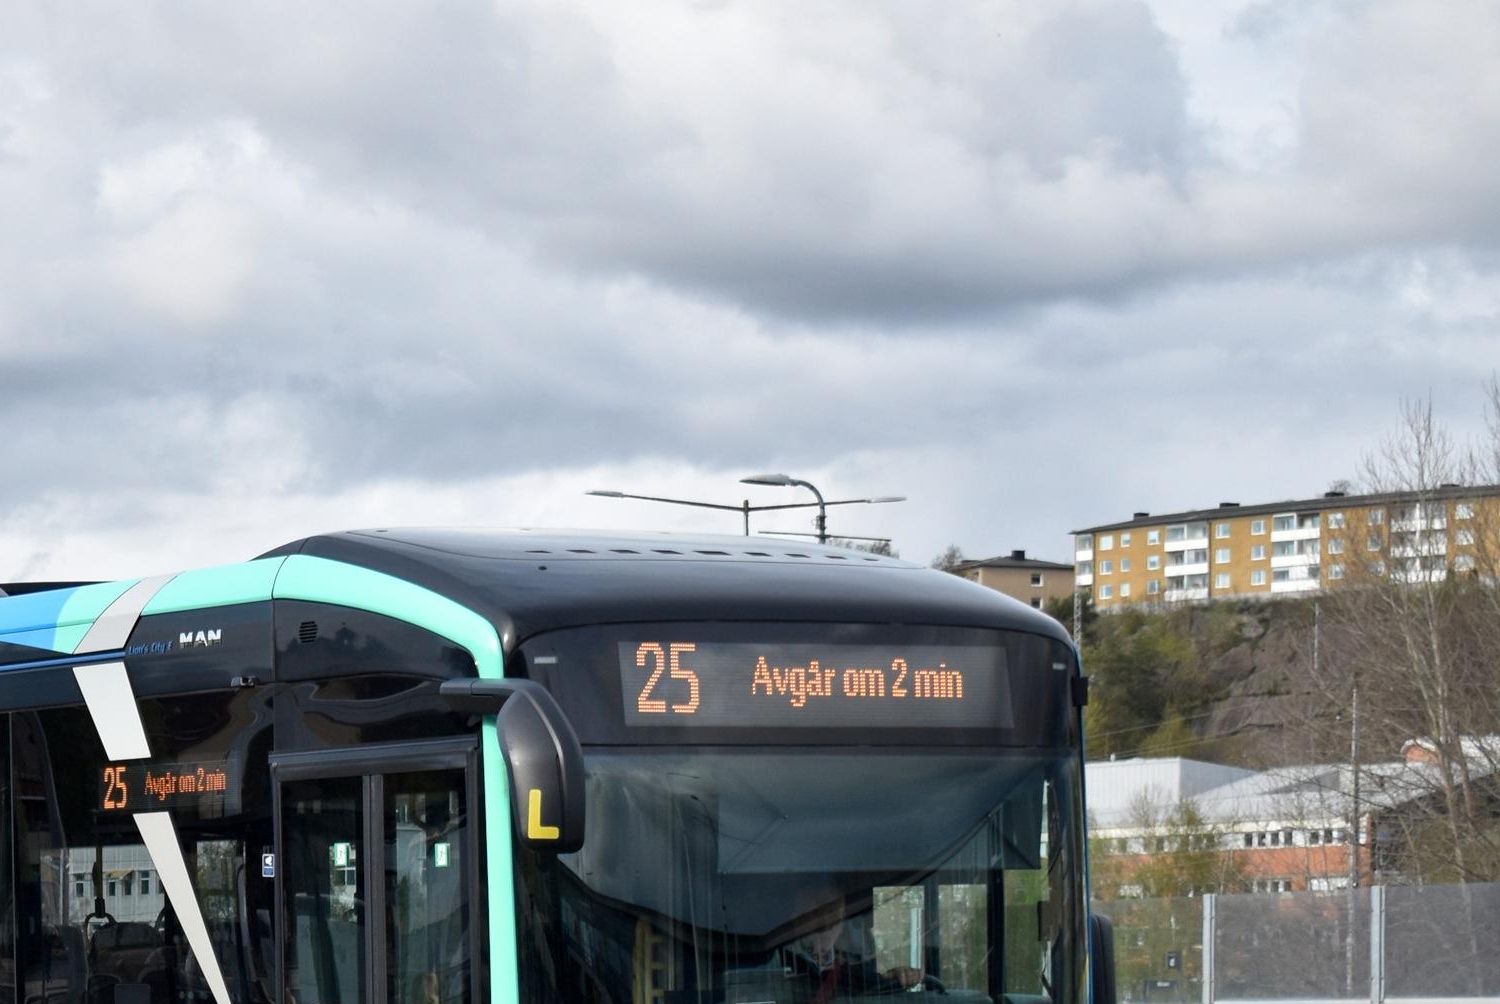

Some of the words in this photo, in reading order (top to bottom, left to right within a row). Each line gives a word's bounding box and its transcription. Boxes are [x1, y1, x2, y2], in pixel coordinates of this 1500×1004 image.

[151, 641, 165, 653] City
[180, 629, 222, 648] MAN
[636, 642, 699, 713] 25
[752, 655, 835, 707] Avgår
[843, 669, 885, 697] om
[892, 658, 908, 697] 2
[915, 663, 962, 698] min
[104, 766, 128, 809] 25
[144, 771, 177, 801] Avgår
[179, 775, 196, 793] om
[197, 767, 204, 791] 2
[206, 769, 226, 791] min
[528, 789, 559, 839] L
